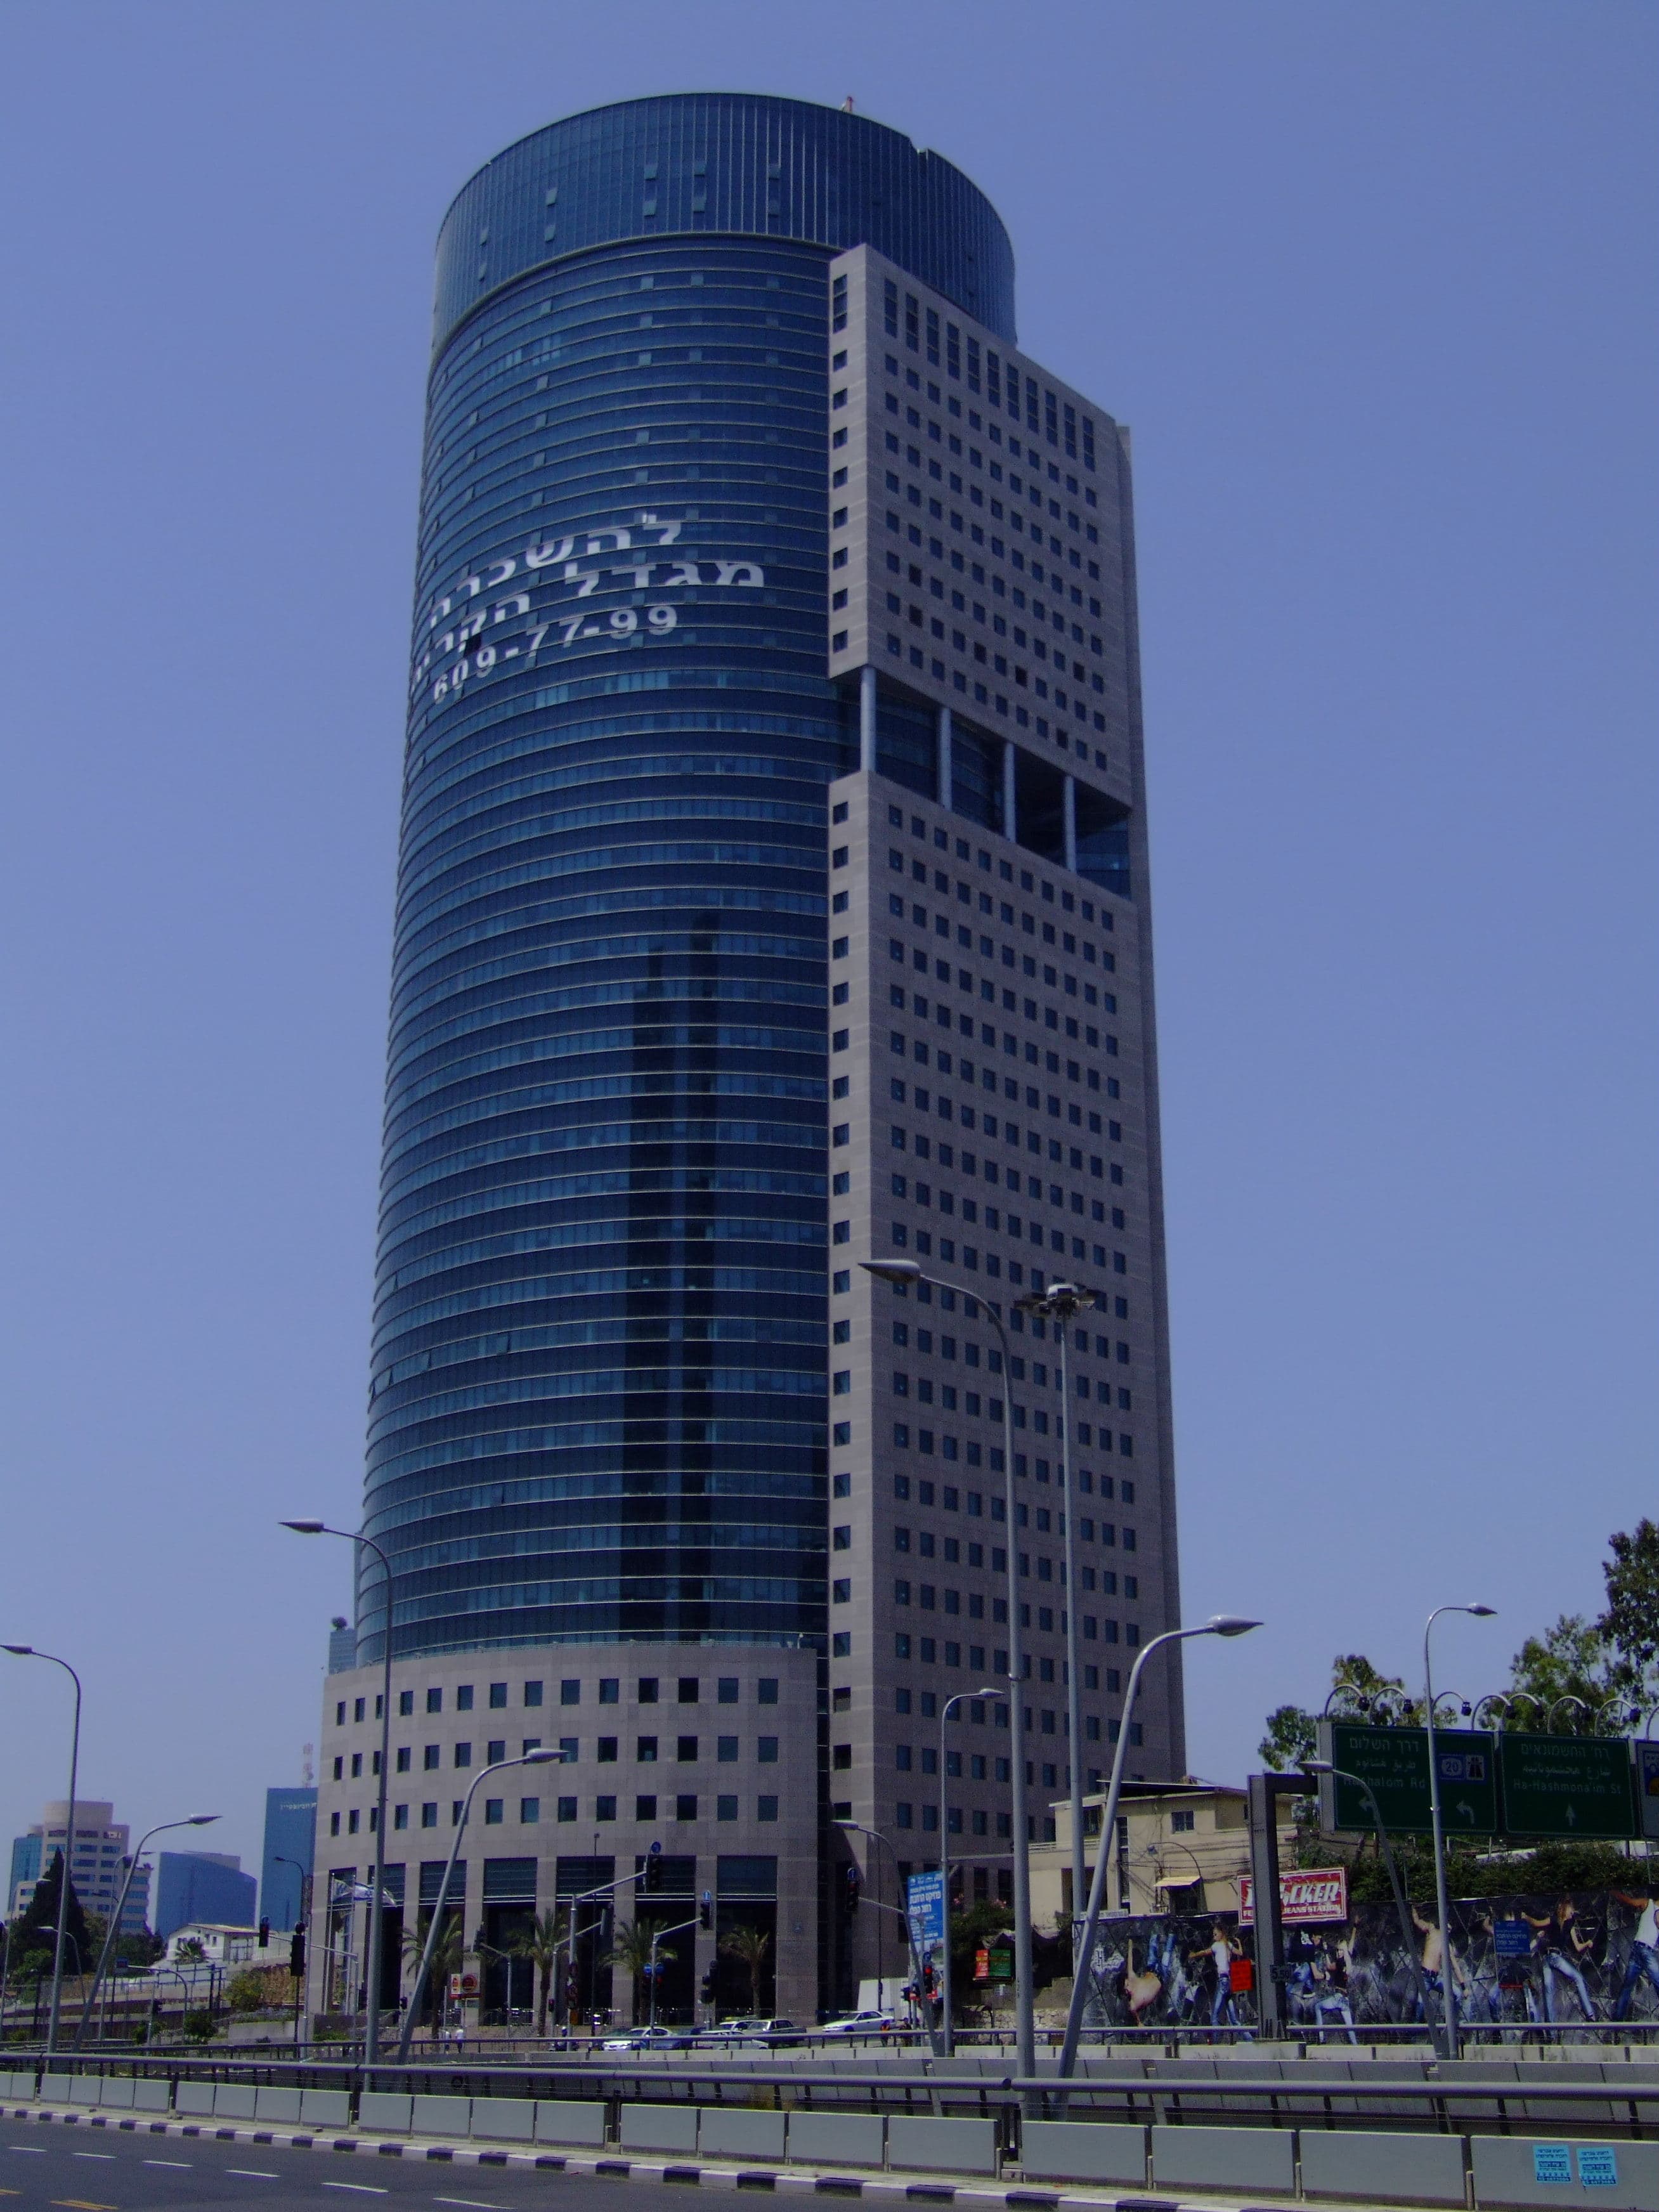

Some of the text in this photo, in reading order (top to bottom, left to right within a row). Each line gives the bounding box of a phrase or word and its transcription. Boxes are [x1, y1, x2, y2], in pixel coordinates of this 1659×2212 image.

[564, 561, 765, 598] מגדל
[1349, 1735, 1419, 1755] דרך השלום
